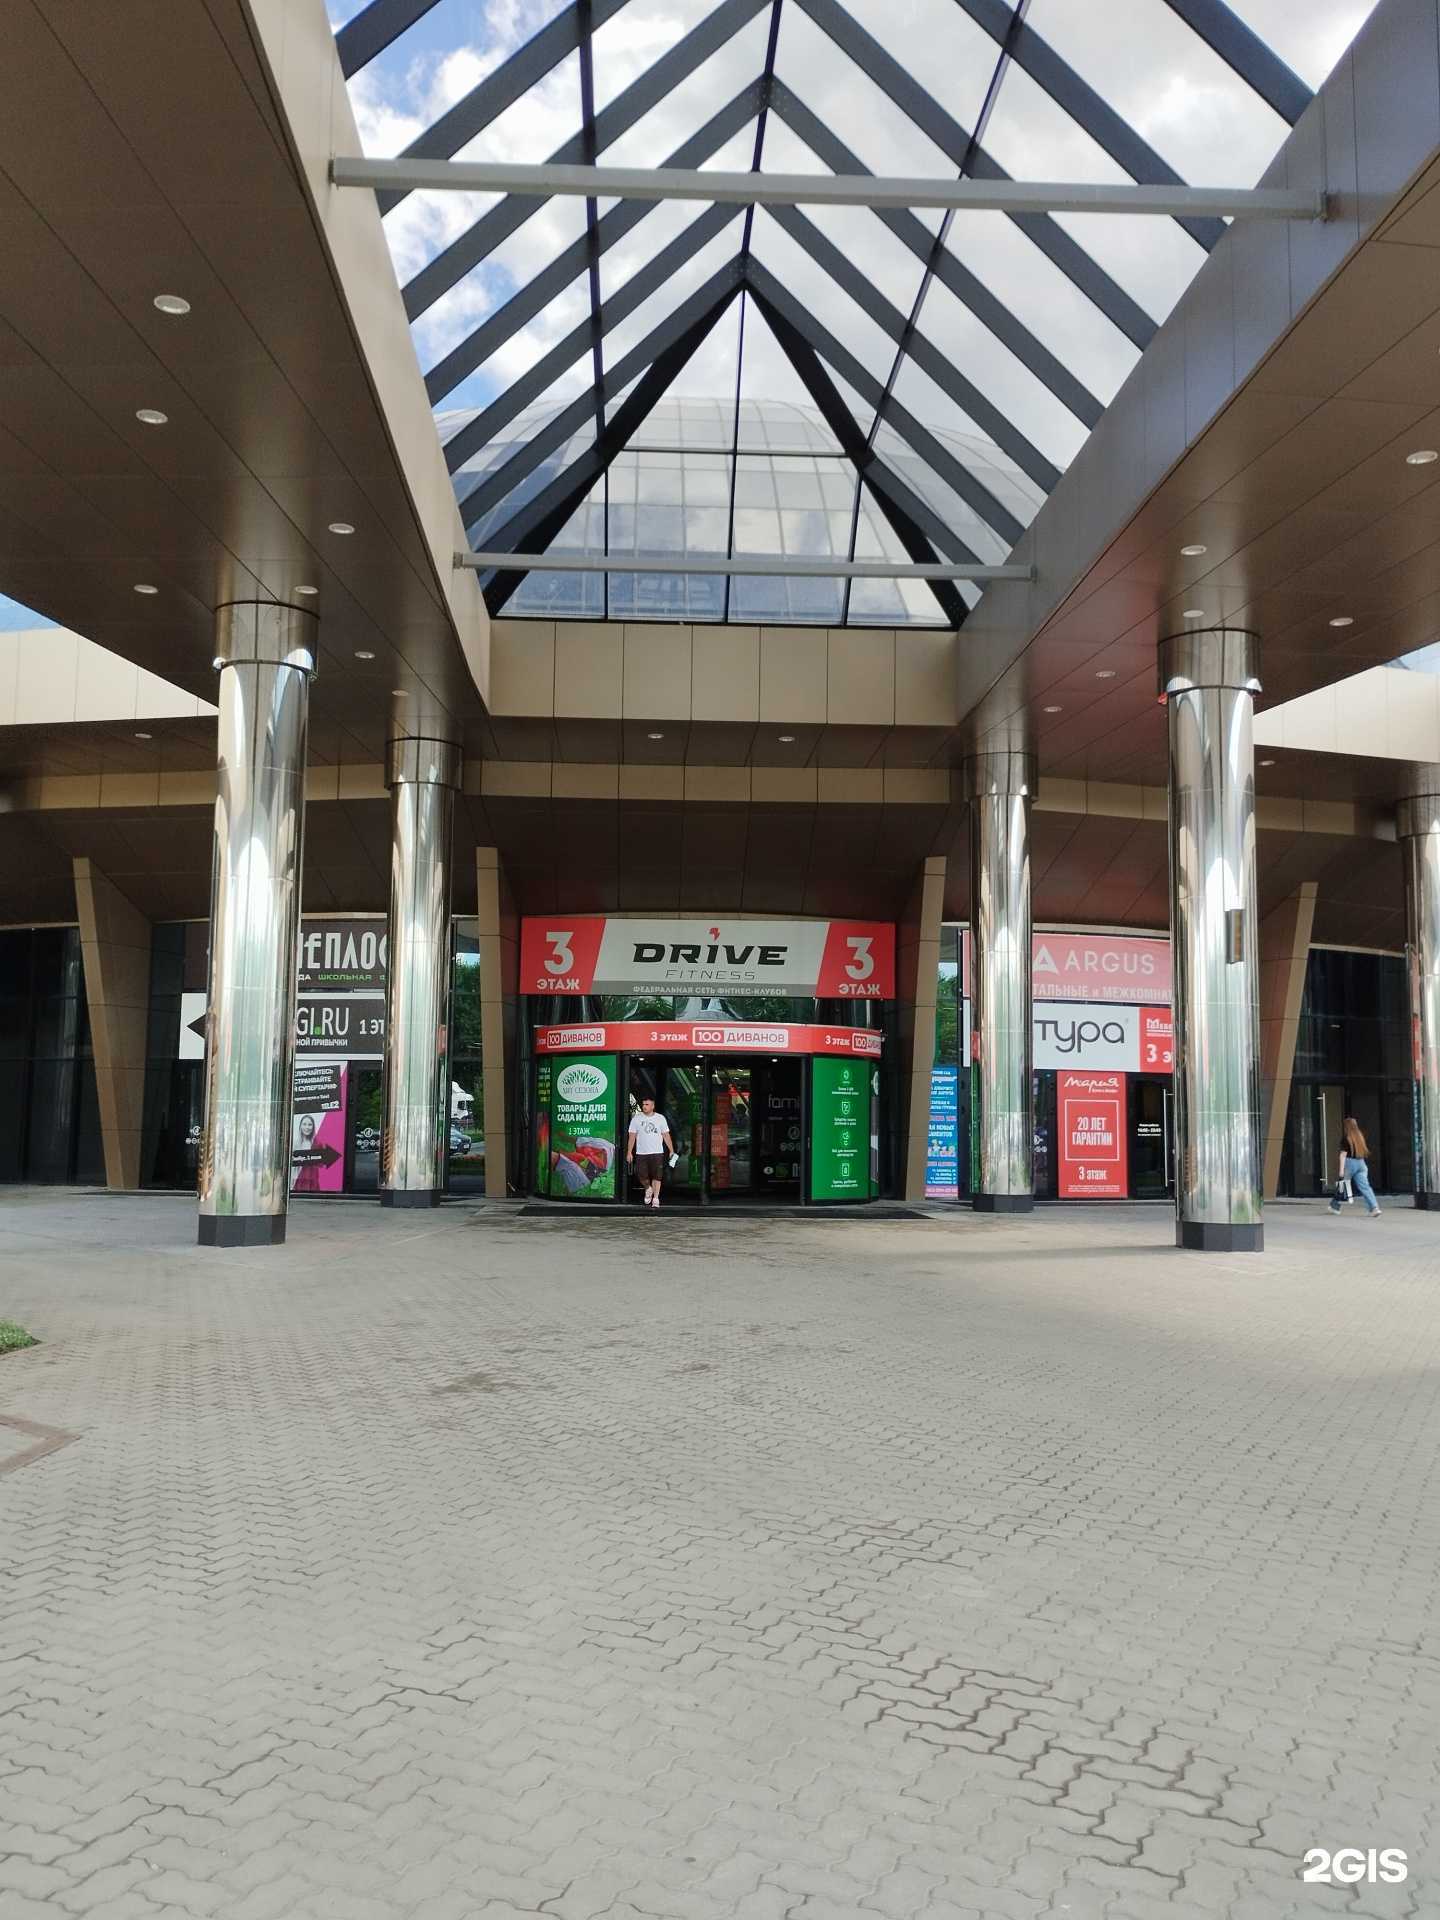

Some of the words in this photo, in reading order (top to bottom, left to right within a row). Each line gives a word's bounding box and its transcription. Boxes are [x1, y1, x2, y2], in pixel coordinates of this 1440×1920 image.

[544, 931, 575, 975] 3
[632, 942, 788, 965] DRIVE
[844, 936, 875, 980] 3
[1064, 949, 1155, 975] ARGUS
[318, 973, 372, 981] ШКОЛЬНАЯ
[665, 969, 756, 981] FITNESS
[536, 978, 580, 991] ЭТАЖ
[633, 985, 693, 994] ФЕДЕРАЛЬНАЯ
[695, 987, 716, 995] СЕТЬ
[717, 987, 788, 996] ФИТНЕС-КЛУБОВ
[838, 983, 881, 996] ЭТАЖ
[369, 1019, 385, 1035] ЭТ
[311, 1038, 348, 1047] ПРИВЫЧКИ
[561, 1032, 602, 1044] ДИВАНОВ
[649, 1031, 658, 1041] 3
[660, 1032, 688, 1041] этаж
[698, 1031, 722, 1042] 100
[726, 1032, 785, 1043] ДИВАНОВ
[825, 1035, 831, 1045] 3
[1146, 1043, 1158, 1064] 3
[1064, 1076, 1120, 1094] Мария
[557, 1104, 587, 1113] ТОВАРЫ
[588, 1104, 607, 1113] ДЛЯ
[557, 1114, 575, 1123] САДА
[576, 1113, 582, 1121] И
[583, 1114, 607, 1123] ДАЧИ
[1078, 1116, 1089, 1131] 20
[1091, 1117, 1107, 1131] ЛЕТ
[574, 1127, 591, 1136] ЭТАЖ
[1071, 1131, 1114, 1147] ГАРАНТИИ
[1078, 1166, 1086, 1181] 3
[1087, 1169, 1107, 1181] этаж
